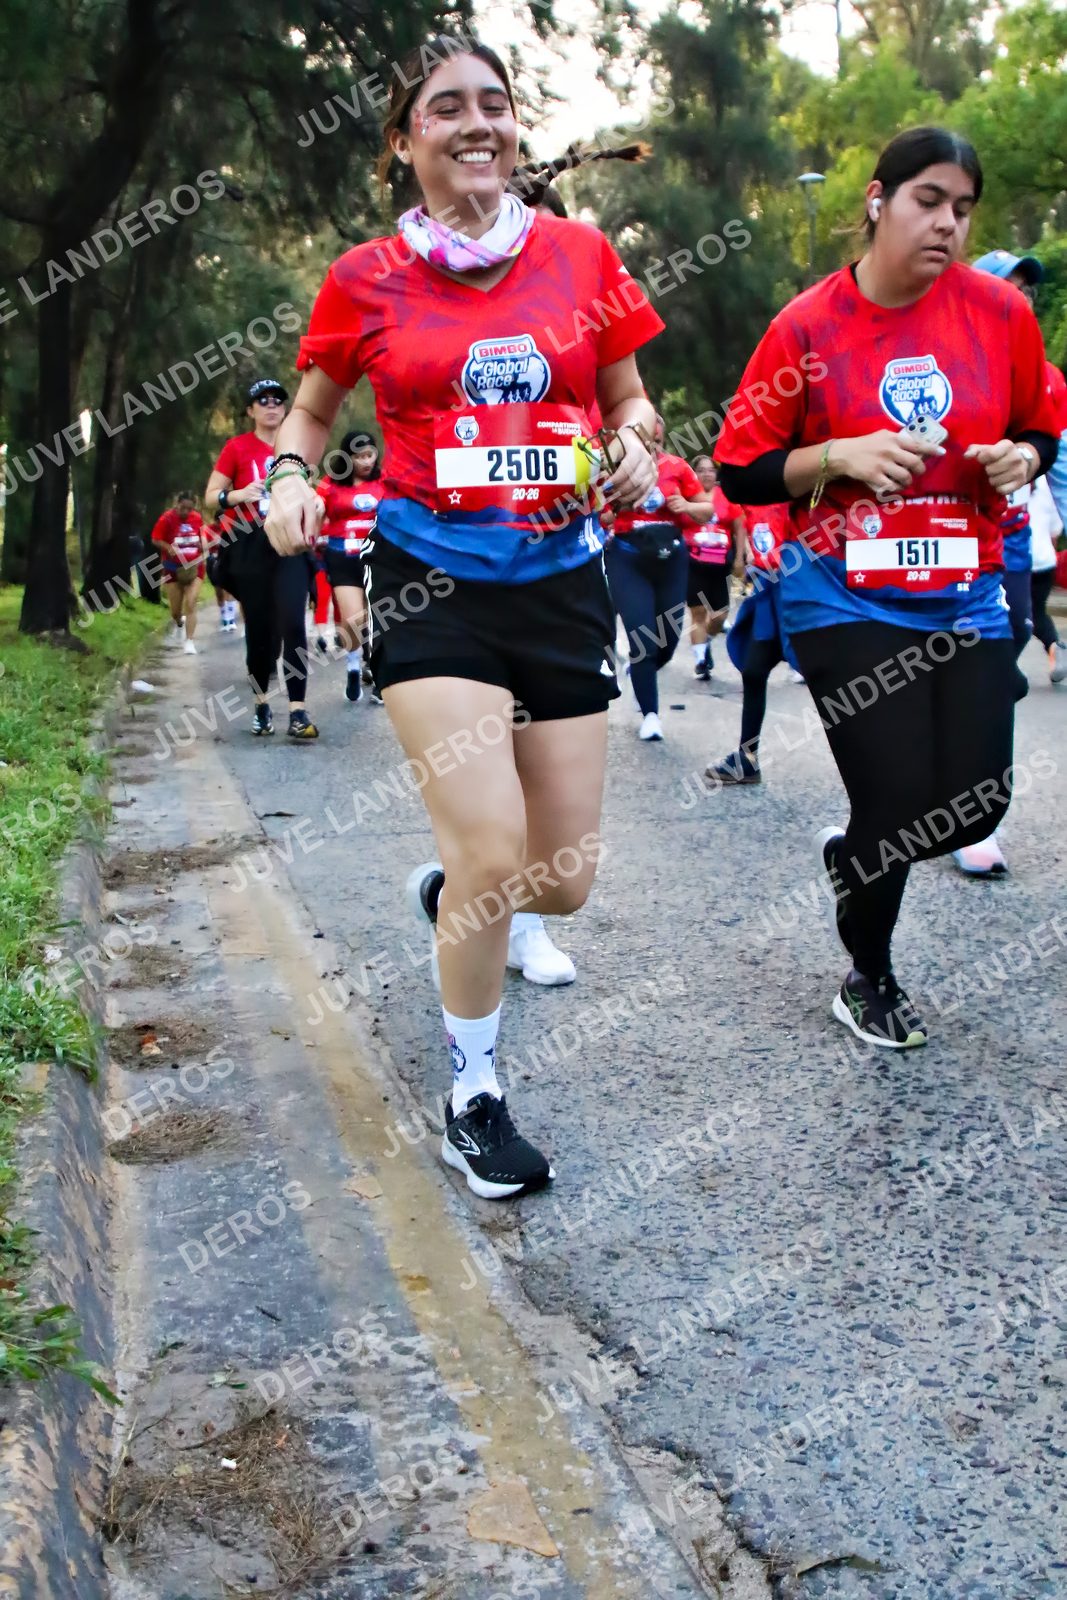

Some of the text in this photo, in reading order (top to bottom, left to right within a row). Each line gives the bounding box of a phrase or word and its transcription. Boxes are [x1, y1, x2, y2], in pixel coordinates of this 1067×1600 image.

[479, 344, 528, 358] BIMBO
[483, 359, 528, 376] Global
[893, 363, 931, 375] BIMBO
[476, 374, 513, 390] Race
[896, 376, 932, 390] Global
[891, 389, 921, 401] Race
[487, 448, 558, 482] 2506
[896, 539, 940, 566] 1511
[957, 583, 970, 591] 5K
